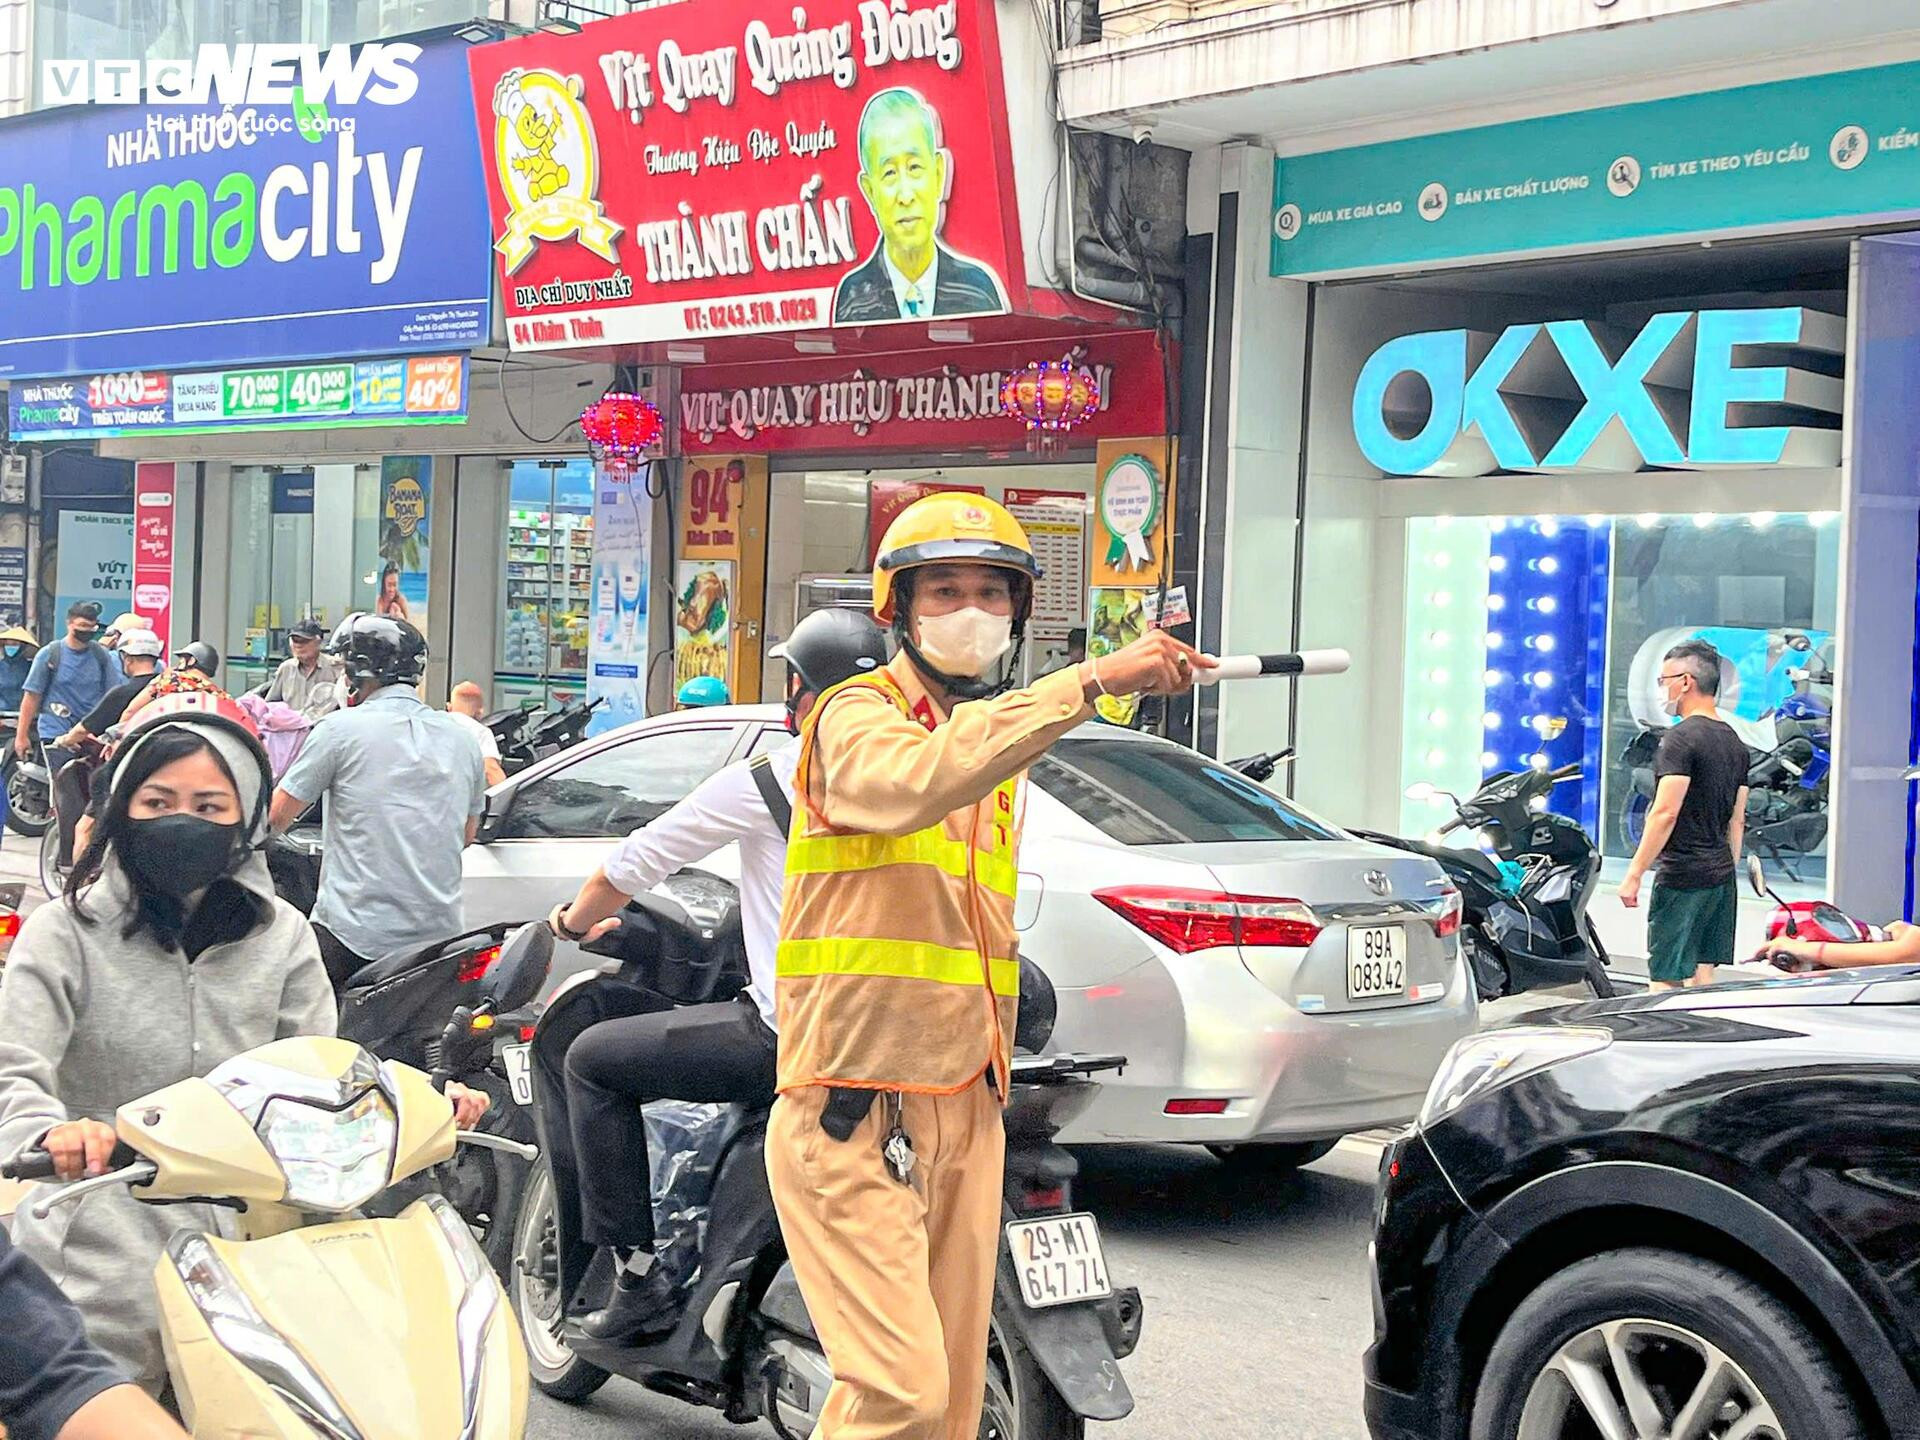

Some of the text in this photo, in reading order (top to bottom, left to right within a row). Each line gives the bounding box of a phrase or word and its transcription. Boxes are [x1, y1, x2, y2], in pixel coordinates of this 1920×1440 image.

[600, 51, 653, 124] Vịt
[658, 39, 737, 112] Quay
[745, 7, 855, 95] Quảng
[644, 145, 699, 175] Thương
[702, 136, 741, 170] Hiệu
[748, 128, 779, 164] Độc
[1878, 127, 1919, 151] KIỂM
[1650, 162, 1675, 179] TÌM
[1678, 160, 1697, 176] XE
[1700, 155, 1740, 173] THEO
[1743, 149, 1774, 167] YÊU
[1455, 175, 1589, 205] BÁN XE CHẤT LƯỢNG
[637, 174, 857, 283] THÀNH CHẤN
[1308, 201, 1402, 225] MUA XE GIÁ CAO
[541, 278, 563, 303] CHỈ
[565, 283, 591, 302] DUY
[594, 270, 631, 298] NHẤT
[514, 323, 531, 344] 94
[23, 383, 74, 402] NHÀ THUỐC
[89, 371, 146, 406] 1000
[227, 376, 256, 409] 70
[290, 372, 321, 405] 40
[409, 378, 457, 407] 40%
[731, 384, 811, 438] QUAY
[819, 370, 890, 436] HIỆU
[898, 365, 1001, 423] THÀNH
[1351, 307, 1802, 476] OKXE
[20, 402, 80, 426] Pharmacity
[114, 408, 137, 424] TOÀN
[137, 406, 165, 424] QUỐC
[178, 404, 194, 412] MUA
[691, 467, 729, 525] 94
[91, 576, 122, 590] ĐẤT
[98, 560, 128, 575] VỨT
[1365, 929, 1392, 959] 89A
[1353, 960, 1402, 992] 083.42
[1023, 1221, 1089, 1261] 29-M1
[1026, 1257, 1105, 1301] 647.74
